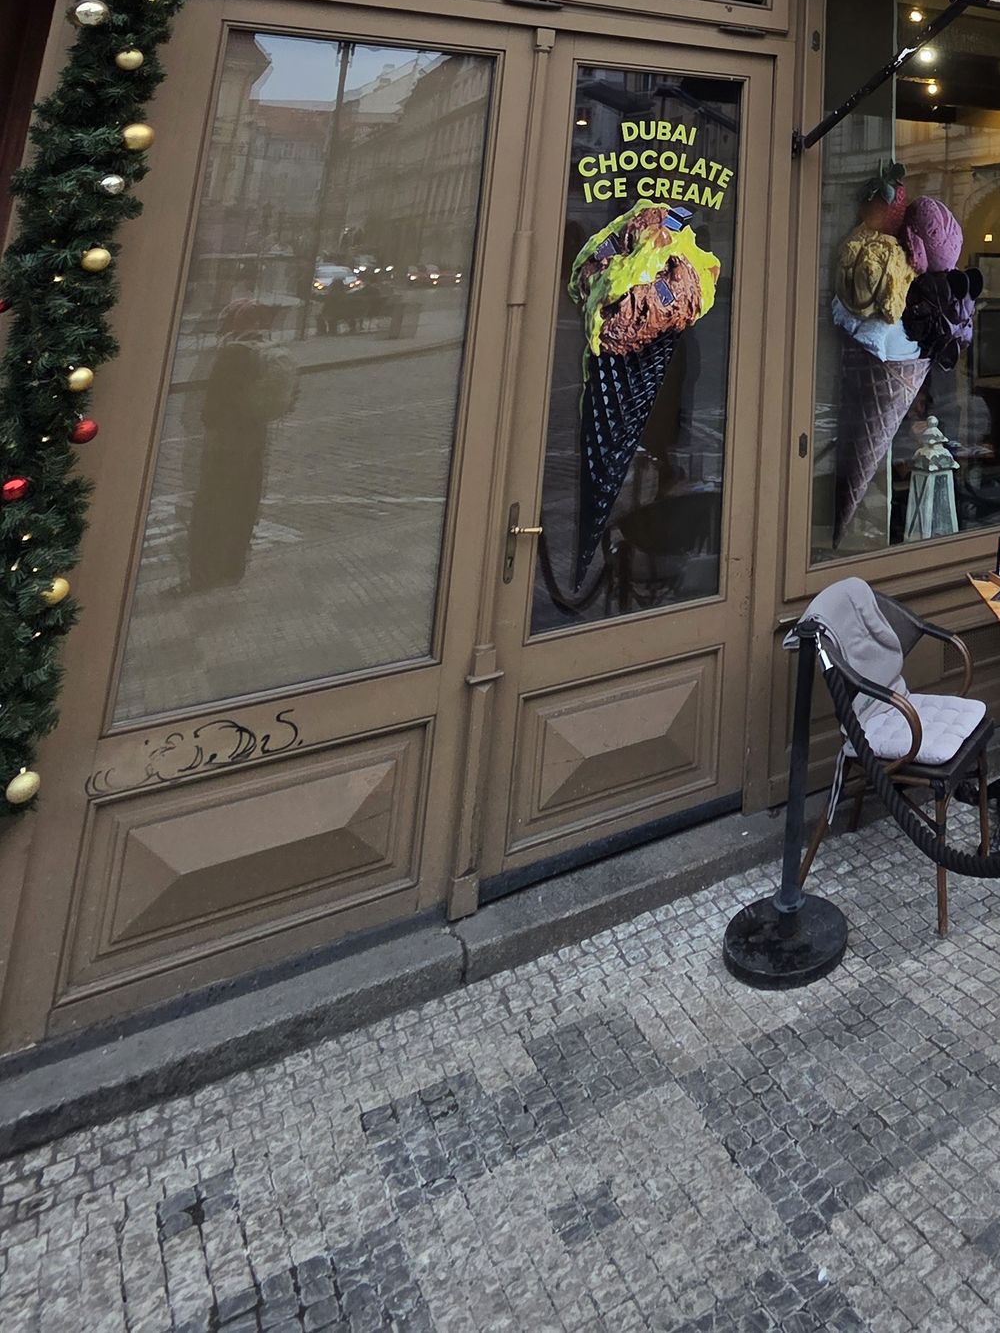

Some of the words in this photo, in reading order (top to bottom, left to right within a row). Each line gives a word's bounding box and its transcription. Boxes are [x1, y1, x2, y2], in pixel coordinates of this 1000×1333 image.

[621, 120, 698, 147] DUBAI
[577, 150, 735, 189] CHOCOLATE
[583, 177, 628, 204] ICE
[636, 176, 726, 211] CREAM
